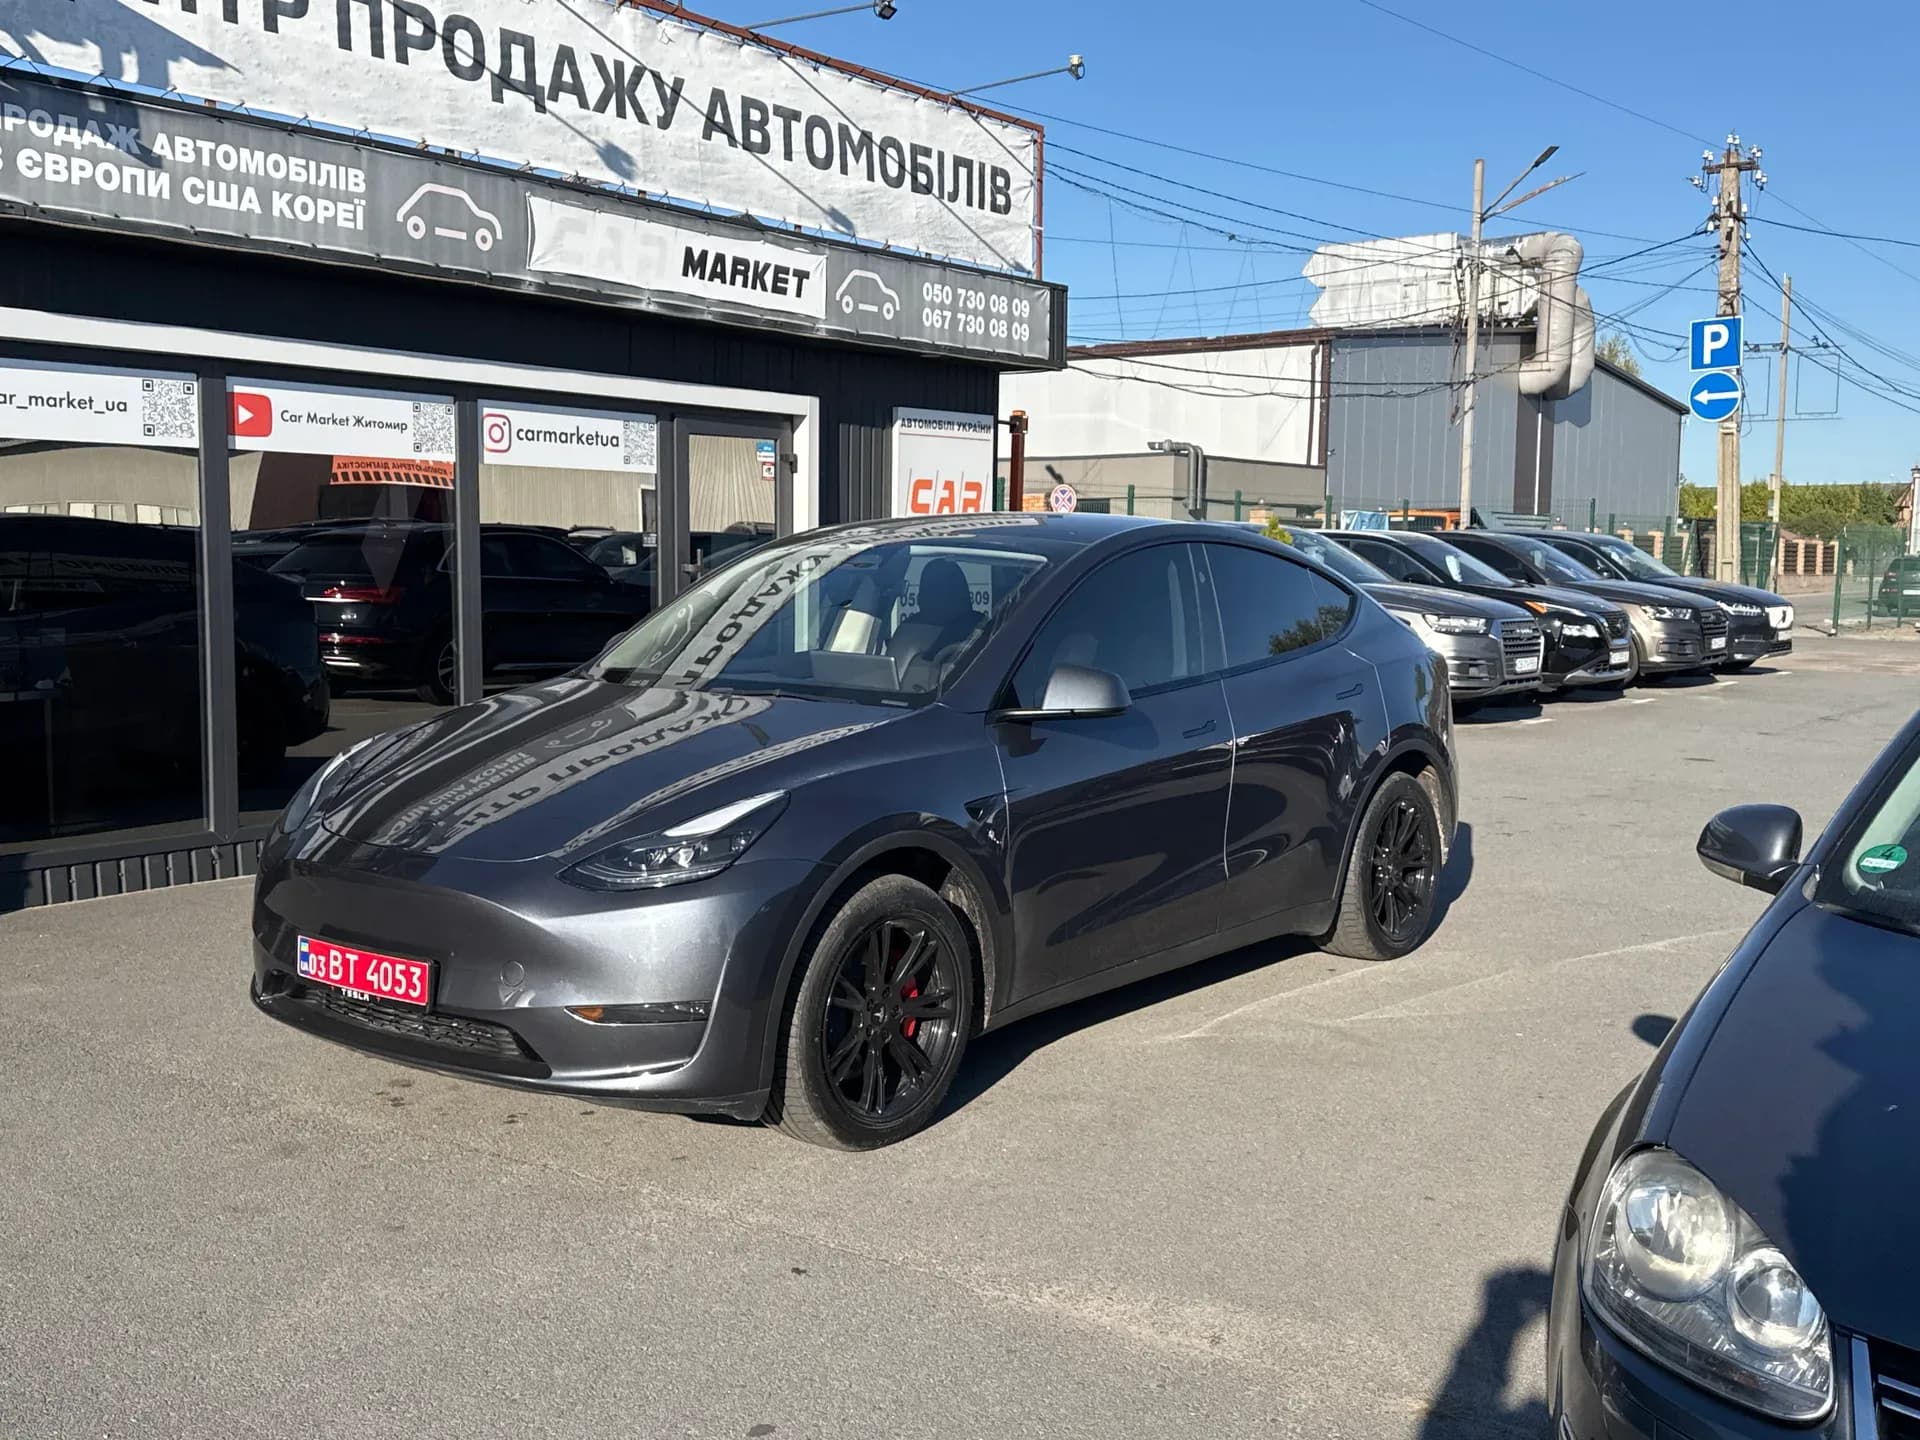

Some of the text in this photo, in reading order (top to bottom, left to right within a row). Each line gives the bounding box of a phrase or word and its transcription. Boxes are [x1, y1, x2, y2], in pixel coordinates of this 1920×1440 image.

[336, 0, 1012, 216] ПРОДАЖУ АВТОМОБІЛІВ
[0, 104, 367, 194] РОДАЖ АВТОМОБІЛІВ
[16, 149, 171, 201] ЄВРОПИ
[182, 176, 262, 215] США
[271, 190, 366, 231] КОРЕЇ
[682, 246, 810, 299] MARKET
[922, 282, 1030, 319] 050 730 08 09
[922, 307, 1030, 342] 067 730 08 09
[1703, 324, 1729, 364] P
[280, 410, 408, 433] Car Market Житомир
[516, 425, 620, 448] carmarketua
[901, 417, 992, 435] АВТОМОБІЛІ УКРАЇНИ
[911, 479, 983, 514] CAR
[341, 988, 370, 1001] TESLA
[366, 959, 421, 998] 4053
